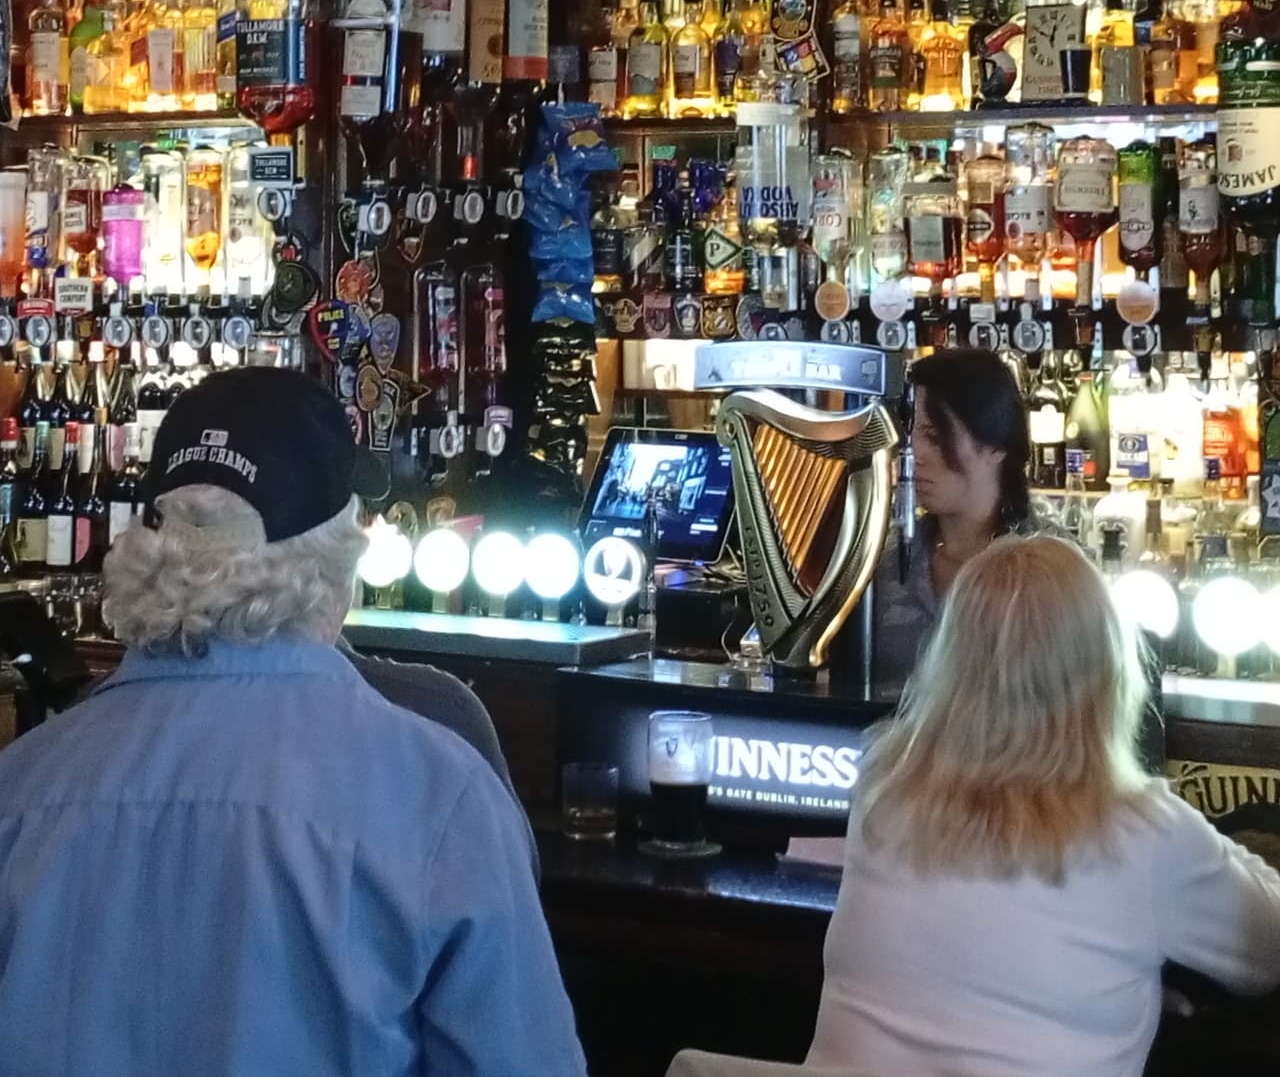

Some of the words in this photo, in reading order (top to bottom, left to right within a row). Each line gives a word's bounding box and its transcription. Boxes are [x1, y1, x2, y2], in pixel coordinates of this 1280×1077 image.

[236, 19, 285, 34] TULLAMORE
[738, 201, 799, 218] ABSOUT
[317, 309, 345, 323] POLICE
[167, 445, 208, 474] LEAGUE
[208, 447, 259, 484] CHAMPS
[750, 571, 776, 627] 1759
[726, 787, 752, 799] GATE
